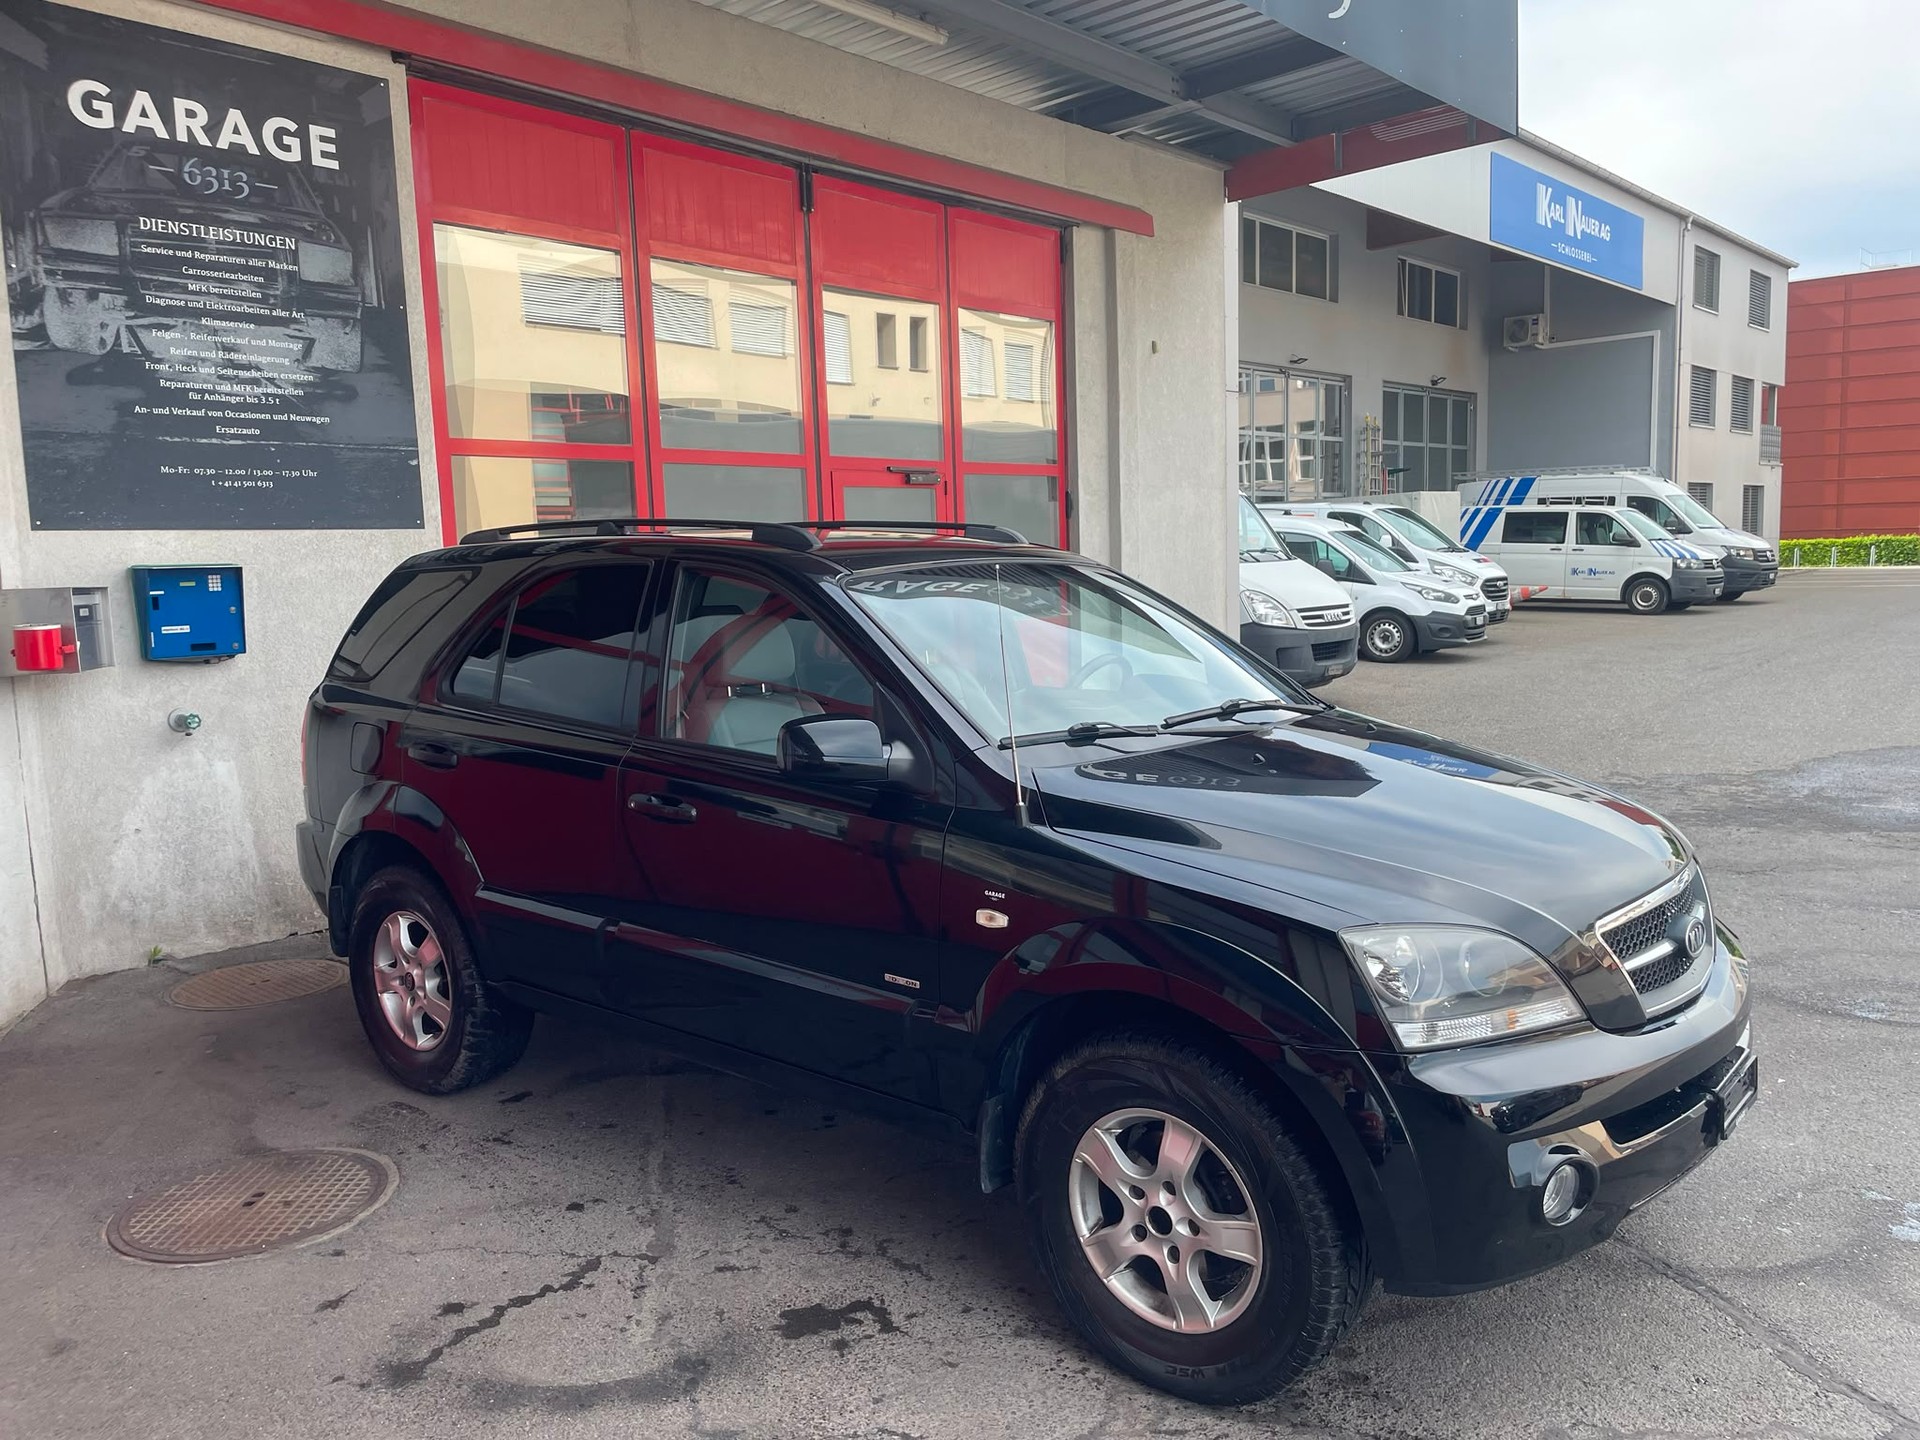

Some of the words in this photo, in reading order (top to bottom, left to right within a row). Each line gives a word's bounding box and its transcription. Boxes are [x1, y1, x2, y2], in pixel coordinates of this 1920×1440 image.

[67, 79, 340, 170] GARAGE
[183, 157, 250, 199] 6313
[138, 216, 296, 250] DIENSTLEISTUNGEN
[1600, 224, 1611, 241] AG
[141, 244, 174, 256] Service
[175, 250, 193, 258] und
[194, 251, 246, 265] Reparaturen
[247, 257, 267, 268] aller
[268, 260, 299, 272] Marken
[182, 265, 264, 283] Carrosseriearbeiten
[188, 283, 208, 292] MFK
[209, 284, 262, 299] bereitstellen
[145, 295, 185, 307] Diagnose
[187, 300, 204, 308] und
[206, 301, 270, 315] Elektroarbeiten
[271, 308, 291, 317] aller
[291, 310, 305, 319] Art
[201, 317, 255, 329] Klimaservice
[190, 332, 249, 346] Reifenverkauf
[268, 339, 303, 351] Montage
[170, 346, 199, 356] Reifen
[199, 350, 216, 358] und
[218, 350, 290, 366] Rädereinlagerung
[175, 363, 197, 373] Heck
[198, 366, 215, 374] und
[217, 366, 279, 379] Seitenscheiben
[280, 372, 314, 382] ersetzen
[160, 379, 213, 390] Reparaturen
[215, 382, 231, 390] und
[233, 384, 252, 392] MFK
[253, 385, 304, 396] bereitstellen
[188, 391, 202, 400] für
[203, 393, 245, 404] Anhänger
[246, 395, 259, 403] bis
[134, 405, 150, 414] An-
[152, 407, 170, 415] und
[171, 407, 206, 417] Verkauf
[224, 410, 271, 420] Occasionen
[272, 413, 288, 421] und
[289, 414, 330, 425] Neuwagen
[215, 425, 260, 435] Ersatzauto
[160, 465, 190, 474] Mo-Fr:
[301, 469, 318, 477] Uhr
